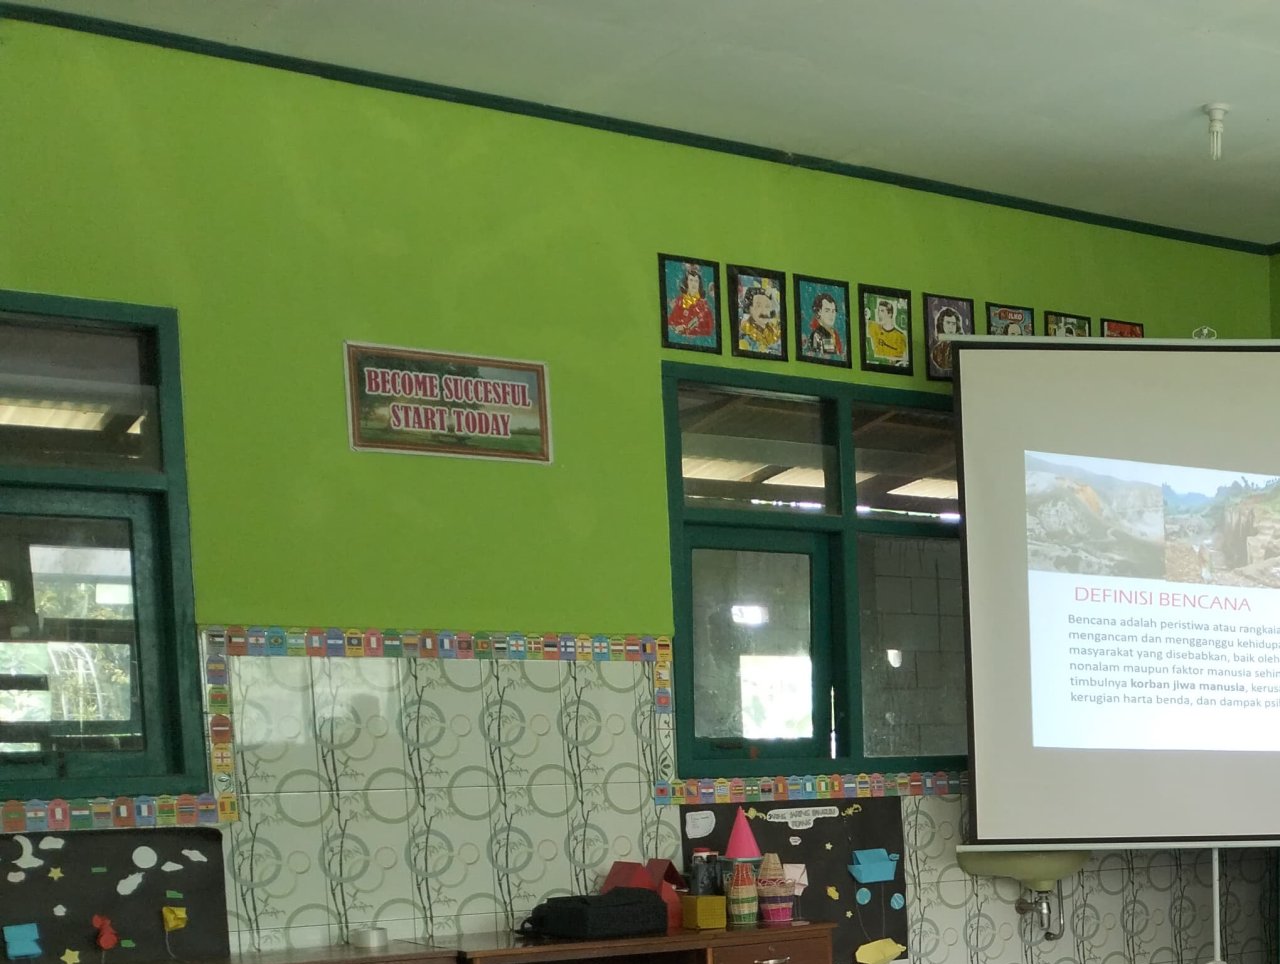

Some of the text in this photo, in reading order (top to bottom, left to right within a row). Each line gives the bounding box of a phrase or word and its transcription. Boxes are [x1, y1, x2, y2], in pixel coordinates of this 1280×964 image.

[365, 368, 531, 407] BECOME SUCCESFUL
[391, 404, 511, 437] START TODAY
[1074, 586, 1252, 612] DEFINISI BENCANA
[1068, 614, 1117, 626] Bencana
[1120, 617, 1157, 628] adalah
[1160, 620, 1210, 631] peristiwa
[1213, 623, 1236, 633] atau
[1068, 631, 1138, 643] mengancam
[1141, 633, 1162, 643] dan
[1165, 635, 1234, 649] mengganggu
[1069, 646, 1133, 658] masyarakat
[1137, 650, 1163, 660] yang
[1233, 652, 1255, 663] baik
[1258, 653, 1280, 664] oleh
[1069, 661, 1120, 673] nonalam
[1123, 664, 1169, 675] maupun
[1172, 664, 1204, 675] faktor
[1207, 667, 1252, 678] manusia
[1070, 676, 1128, 688] timbulnya
[1130, 678, 1170, 690] korban
[1173, 679, 1196, 691] jiwa
[1071, 692, 1120, 704] kerugian
[1123, 693, 1153, 704] harta
[1196, 696, 1217, 706] dan
[1219, 696, 1262, 708] dampak
